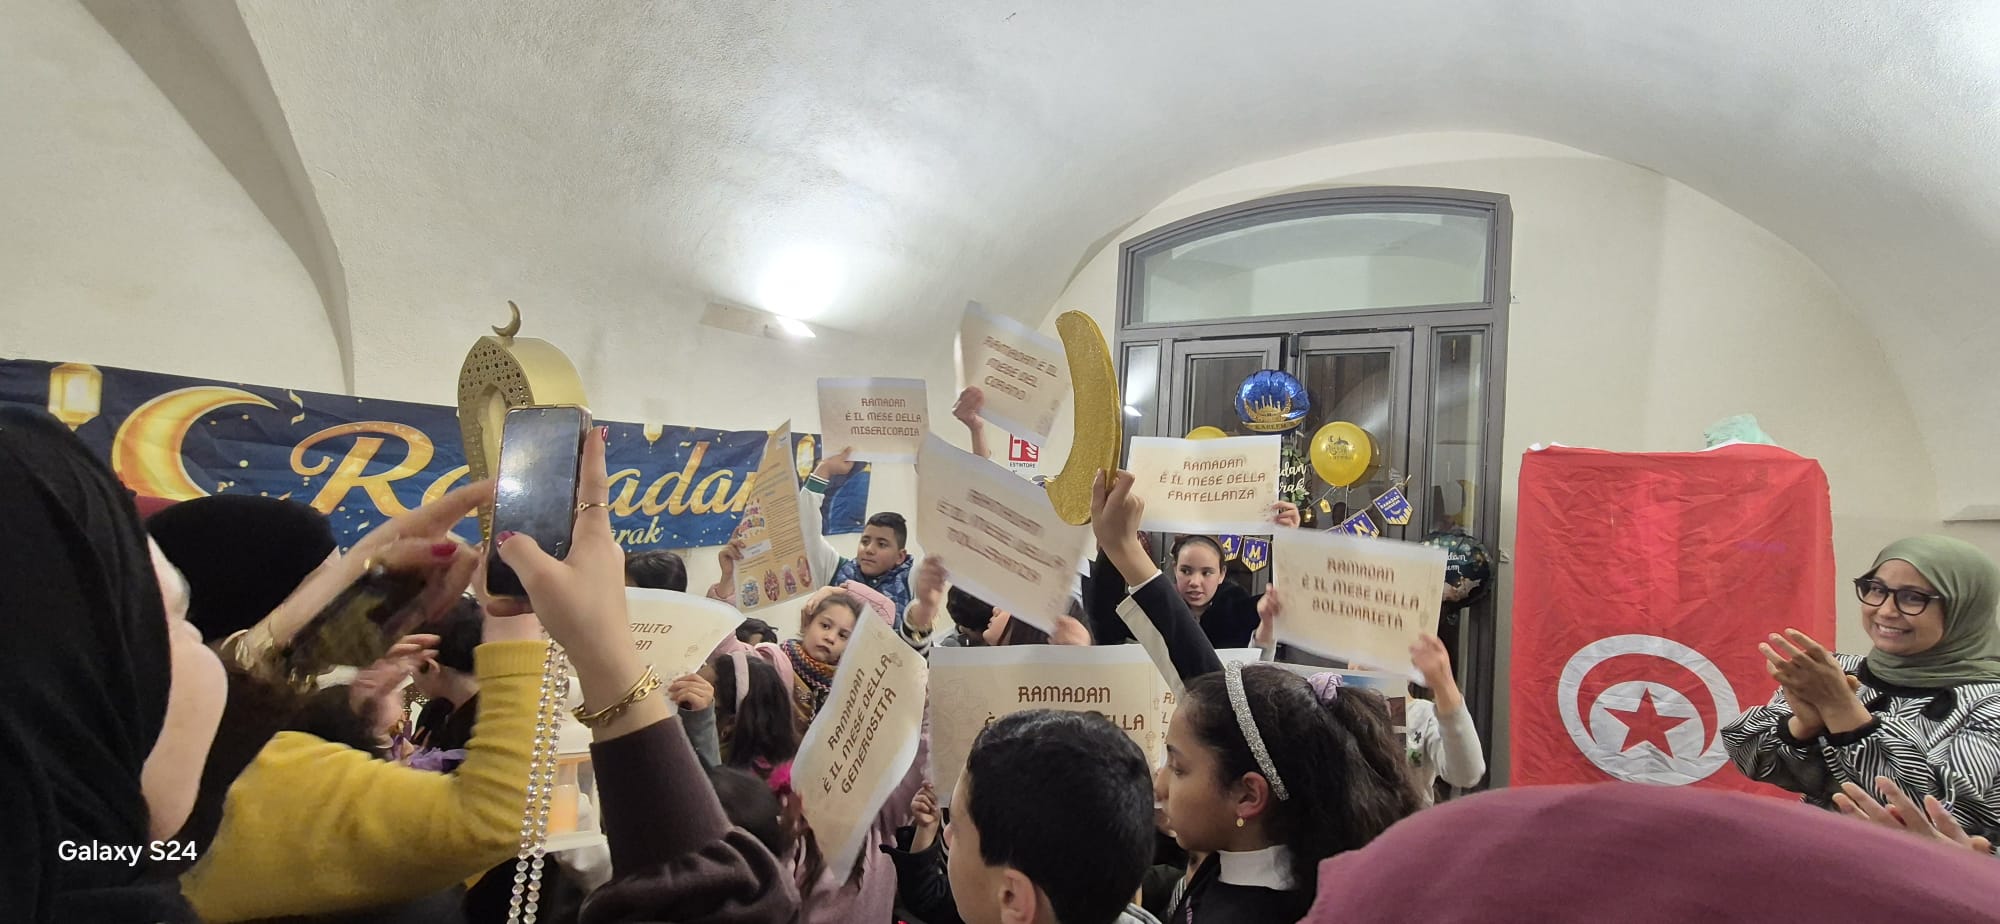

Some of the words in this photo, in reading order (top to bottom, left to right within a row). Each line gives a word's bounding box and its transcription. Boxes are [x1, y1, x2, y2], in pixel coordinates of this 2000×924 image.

[861, 398, 906, 408] RAMADAN
[854, 412, 864, 421] IL
[867, 412, 893, 422] MESE
[895, 413, 922, 423] DELLA
[851, 426, 920, 437] MISERICORDIA
[1183, 457, 1245, 471] RAMADAN
[1171, 472, 1183, 485] IL
[1187, 475, 1222, 486] MESE
[1226, 472, 1266, 484] DELLA
[1167, 489, 1255, 502] FRATELLANZA
[1327, 557, 1395, 584] RAMADAN
[1314, 576, 1327, 593] IL
[1332, 578, 1371, 601] MESE
[1375, 589, 1420, 611] DELLA
[1017, 686, 1111, 703] RAMADAN
[827, 668, 865, 751] RAMADAN
[829, 760, 843, 781] IL
[842, 709, 865, 760] MESE
[863, 654, 893, 710] DELLA
[841, 687, 897, 794] GENEROSITÀ
